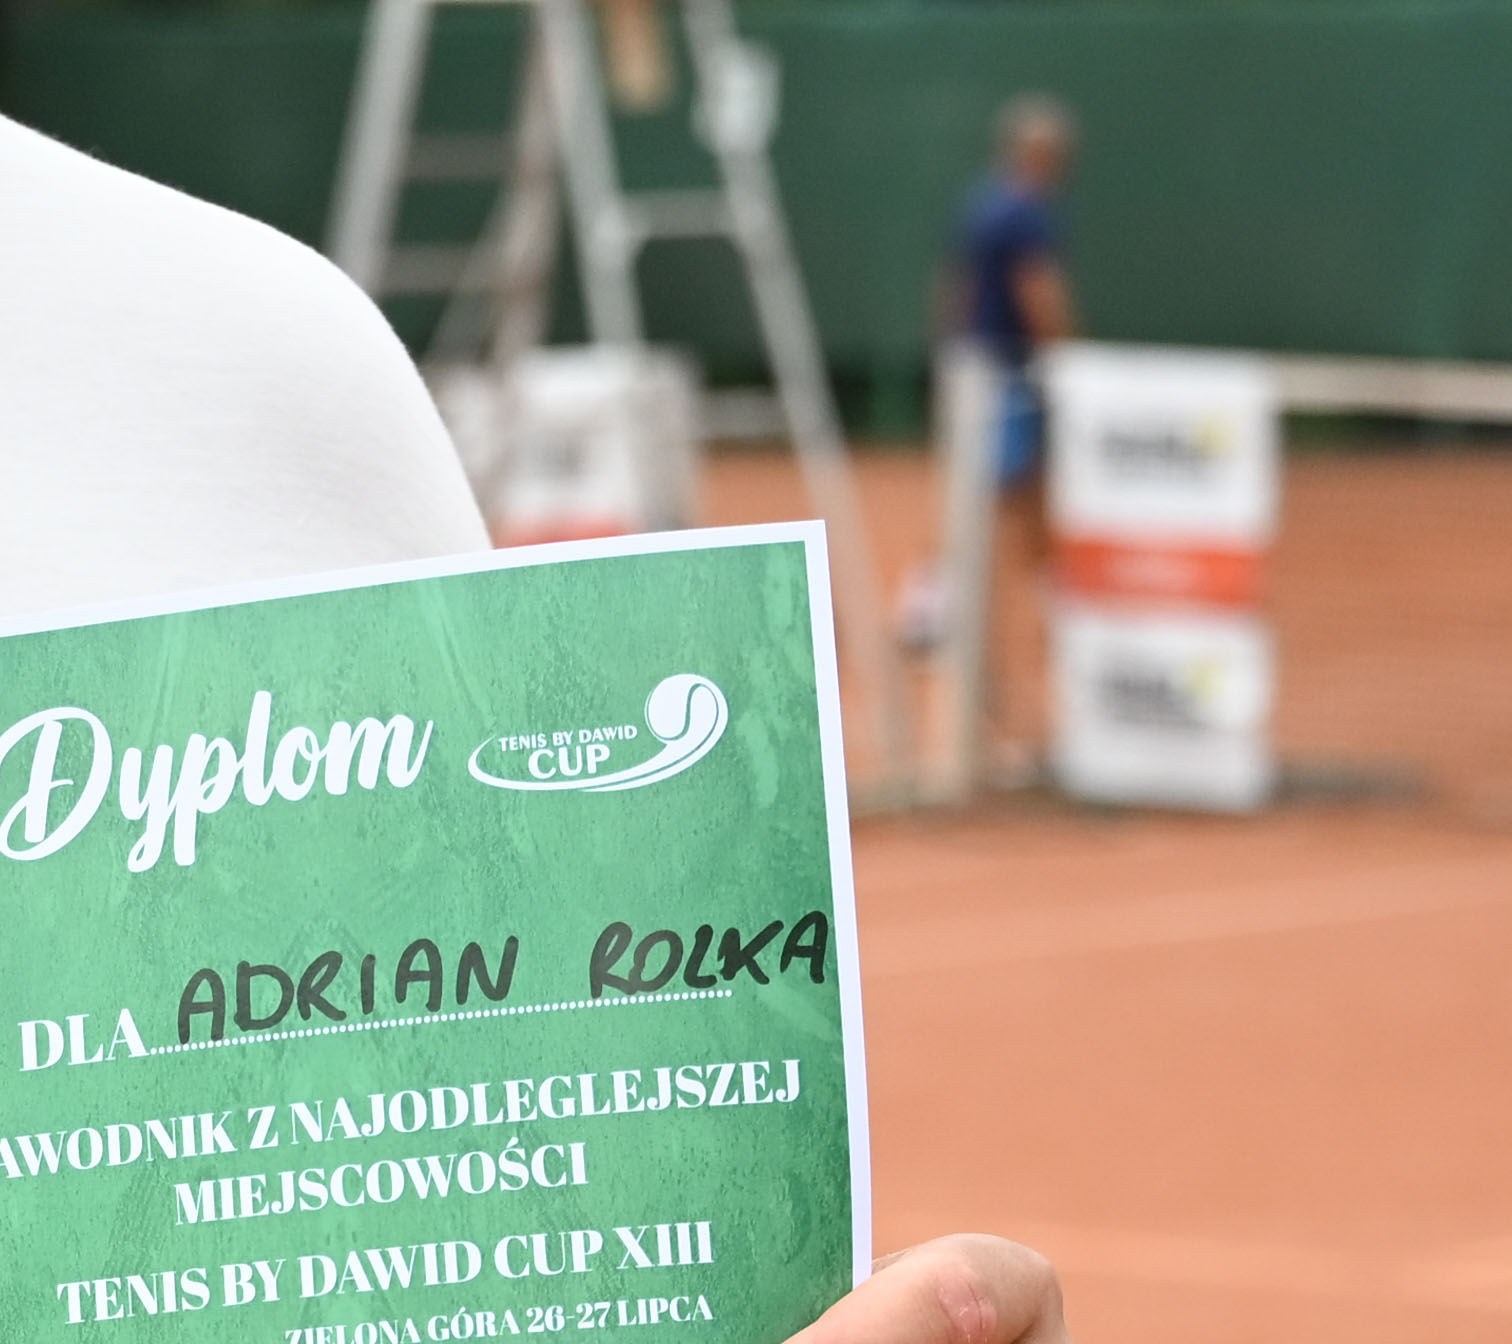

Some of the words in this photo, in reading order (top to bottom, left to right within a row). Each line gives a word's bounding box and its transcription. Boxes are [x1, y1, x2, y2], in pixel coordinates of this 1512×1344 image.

[499, 733, 547, 752] TENIS
[553, 731, 573, 747] BY
[578, 725, 638, 743] DAWID
[528, 744, 611, 779] CUP
[177, 934, 520, 1045] ADRIAN
[588, 909, 828, 1000] ROLKA
[246, 1105, 280, 1151] Z
[289, 1058, 802, 1146] NAJODLEGLEJSZEJ
[174, 1136, 590, 1226] MIEJSCOWOŚCI
[56, 1266, 211, 1325] TENIS
[221, 1258, 287, 1307] BY
[297, 1240, 483, 1299] DAWID
[493, 1229, 605, 1280] CUP
[612, 1220, 715, 1271] XIII
[427, 1307, 521, 1342] GÓRA
[525, 1300, 611, 1334] 26-27
[616, 1294, 714, 1328] LIPCA
